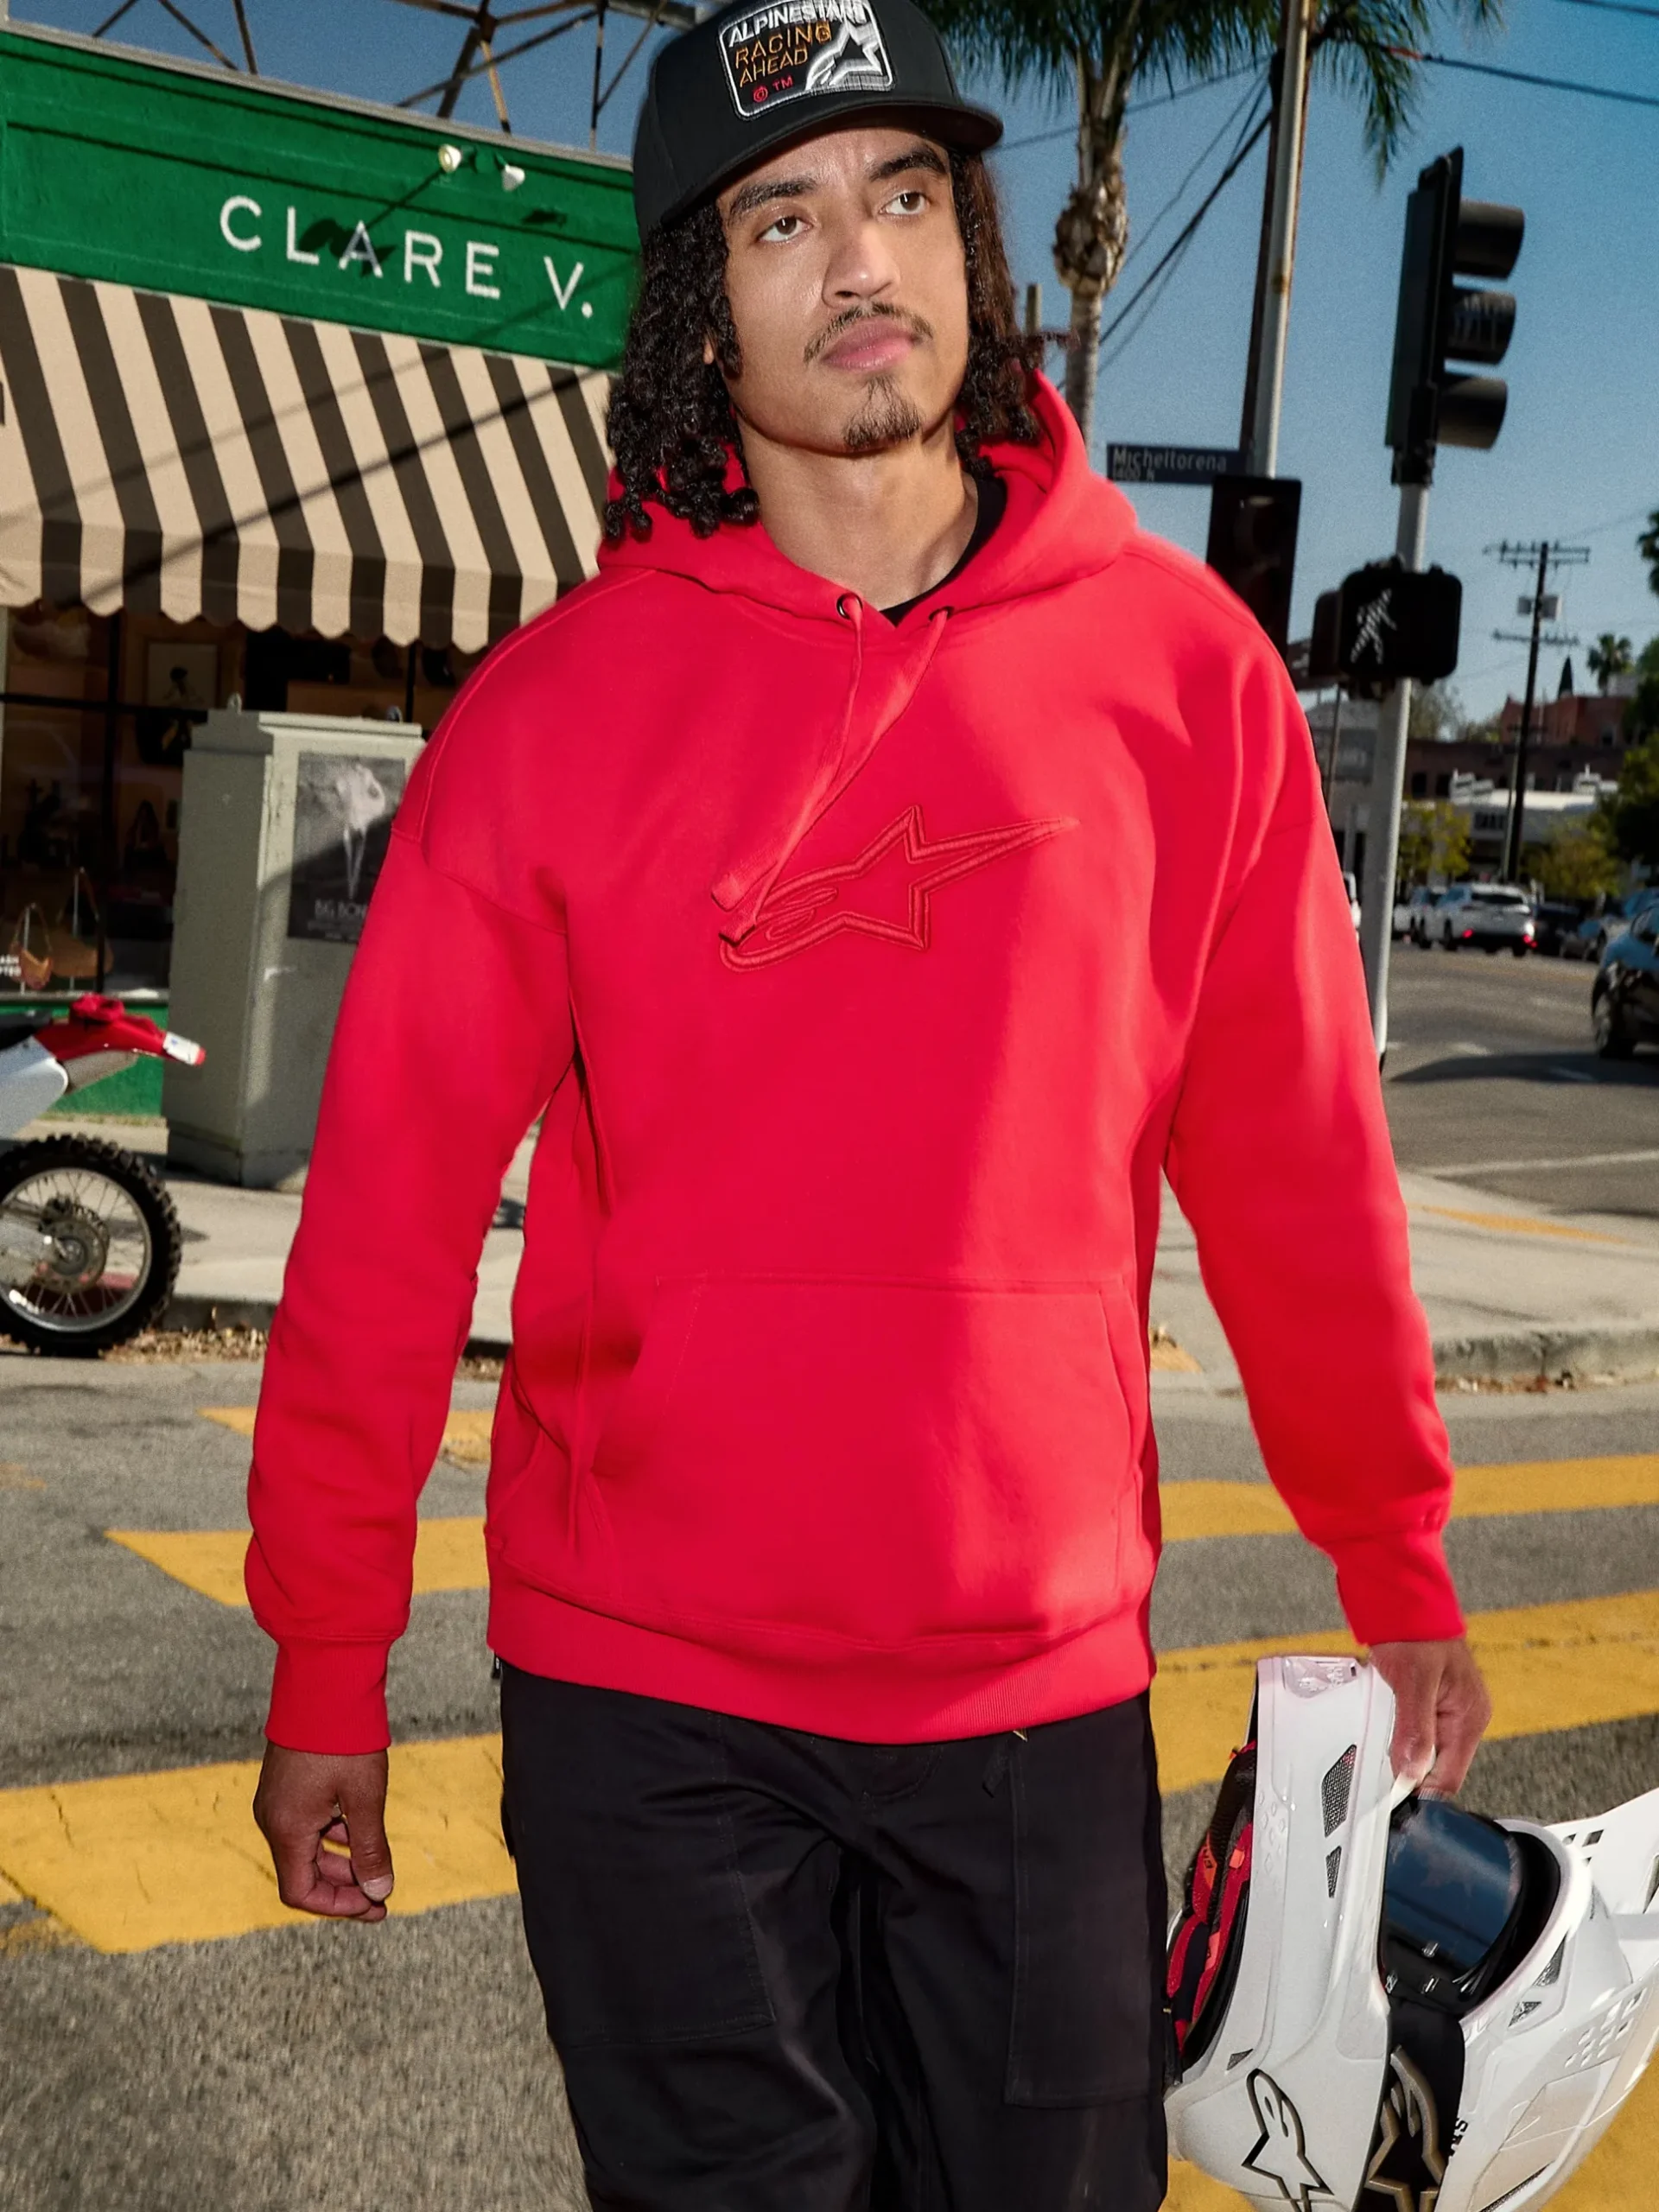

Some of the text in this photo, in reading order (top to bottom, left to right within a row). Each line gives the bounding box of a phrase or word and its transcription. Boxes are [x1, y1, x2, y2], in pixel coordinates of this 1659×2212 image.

[735, 21, 832, 69] RACING
[740, 47, 809, 87] AHEAD
[219, 195, 594, 319] CLARE V.
[1112, 446, 1227, 474] Micheltorena
